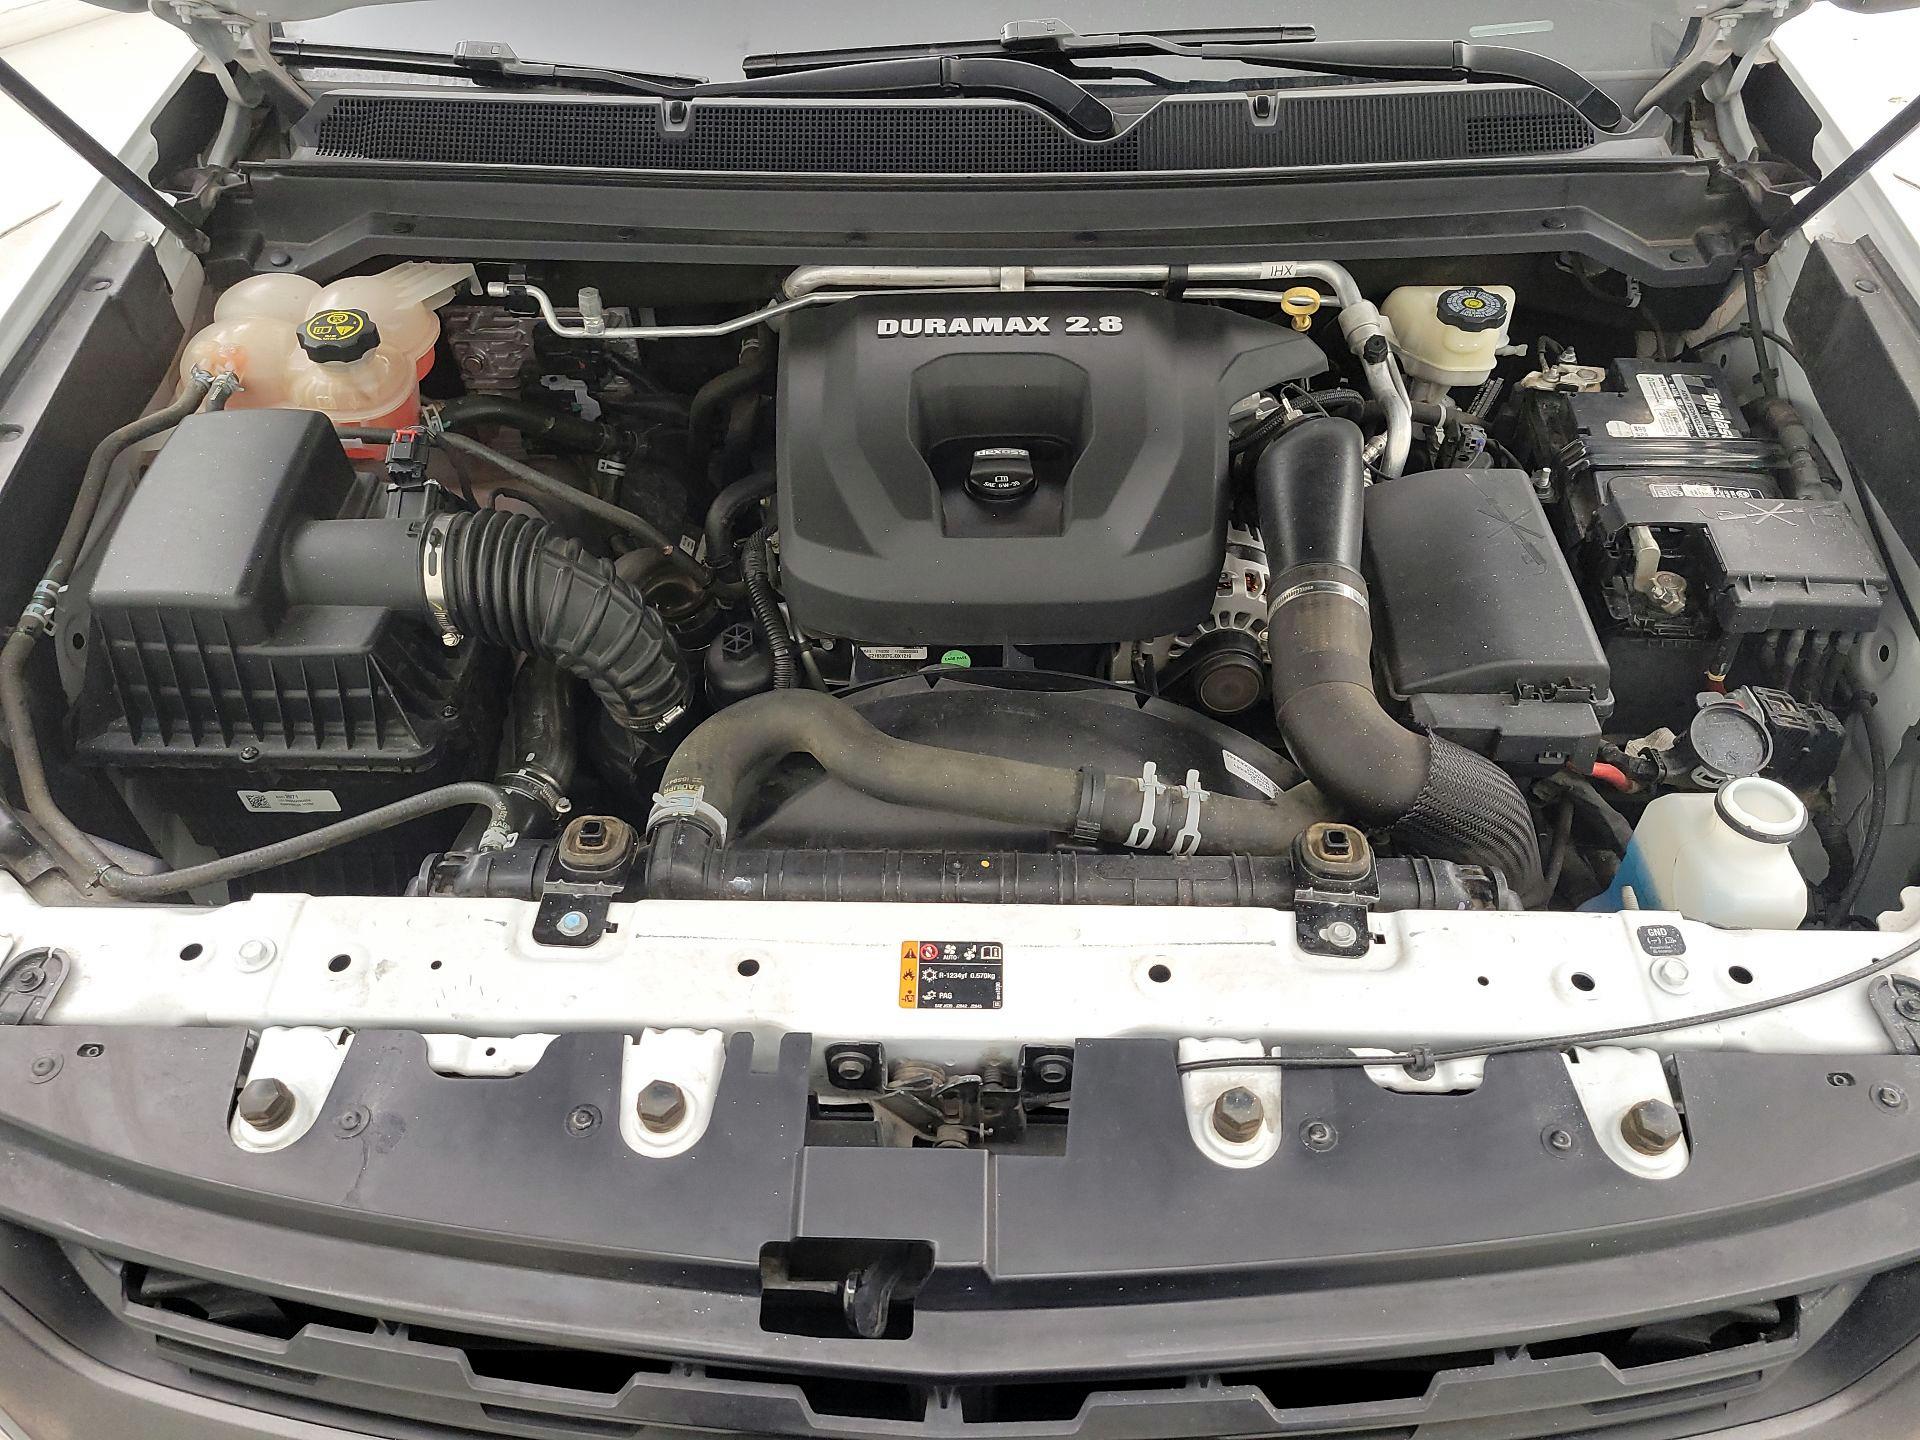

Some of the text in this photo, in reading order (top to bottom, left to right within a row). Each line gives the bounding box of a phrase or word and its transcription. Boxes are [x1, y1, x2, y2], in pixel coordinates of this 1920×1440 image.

[877, 315, 1123, 336] DURAMAX 2.8
[1647, 928, 1667, 936] GND
[939, 972, 996, 980] R-1234yf 0.570kg
